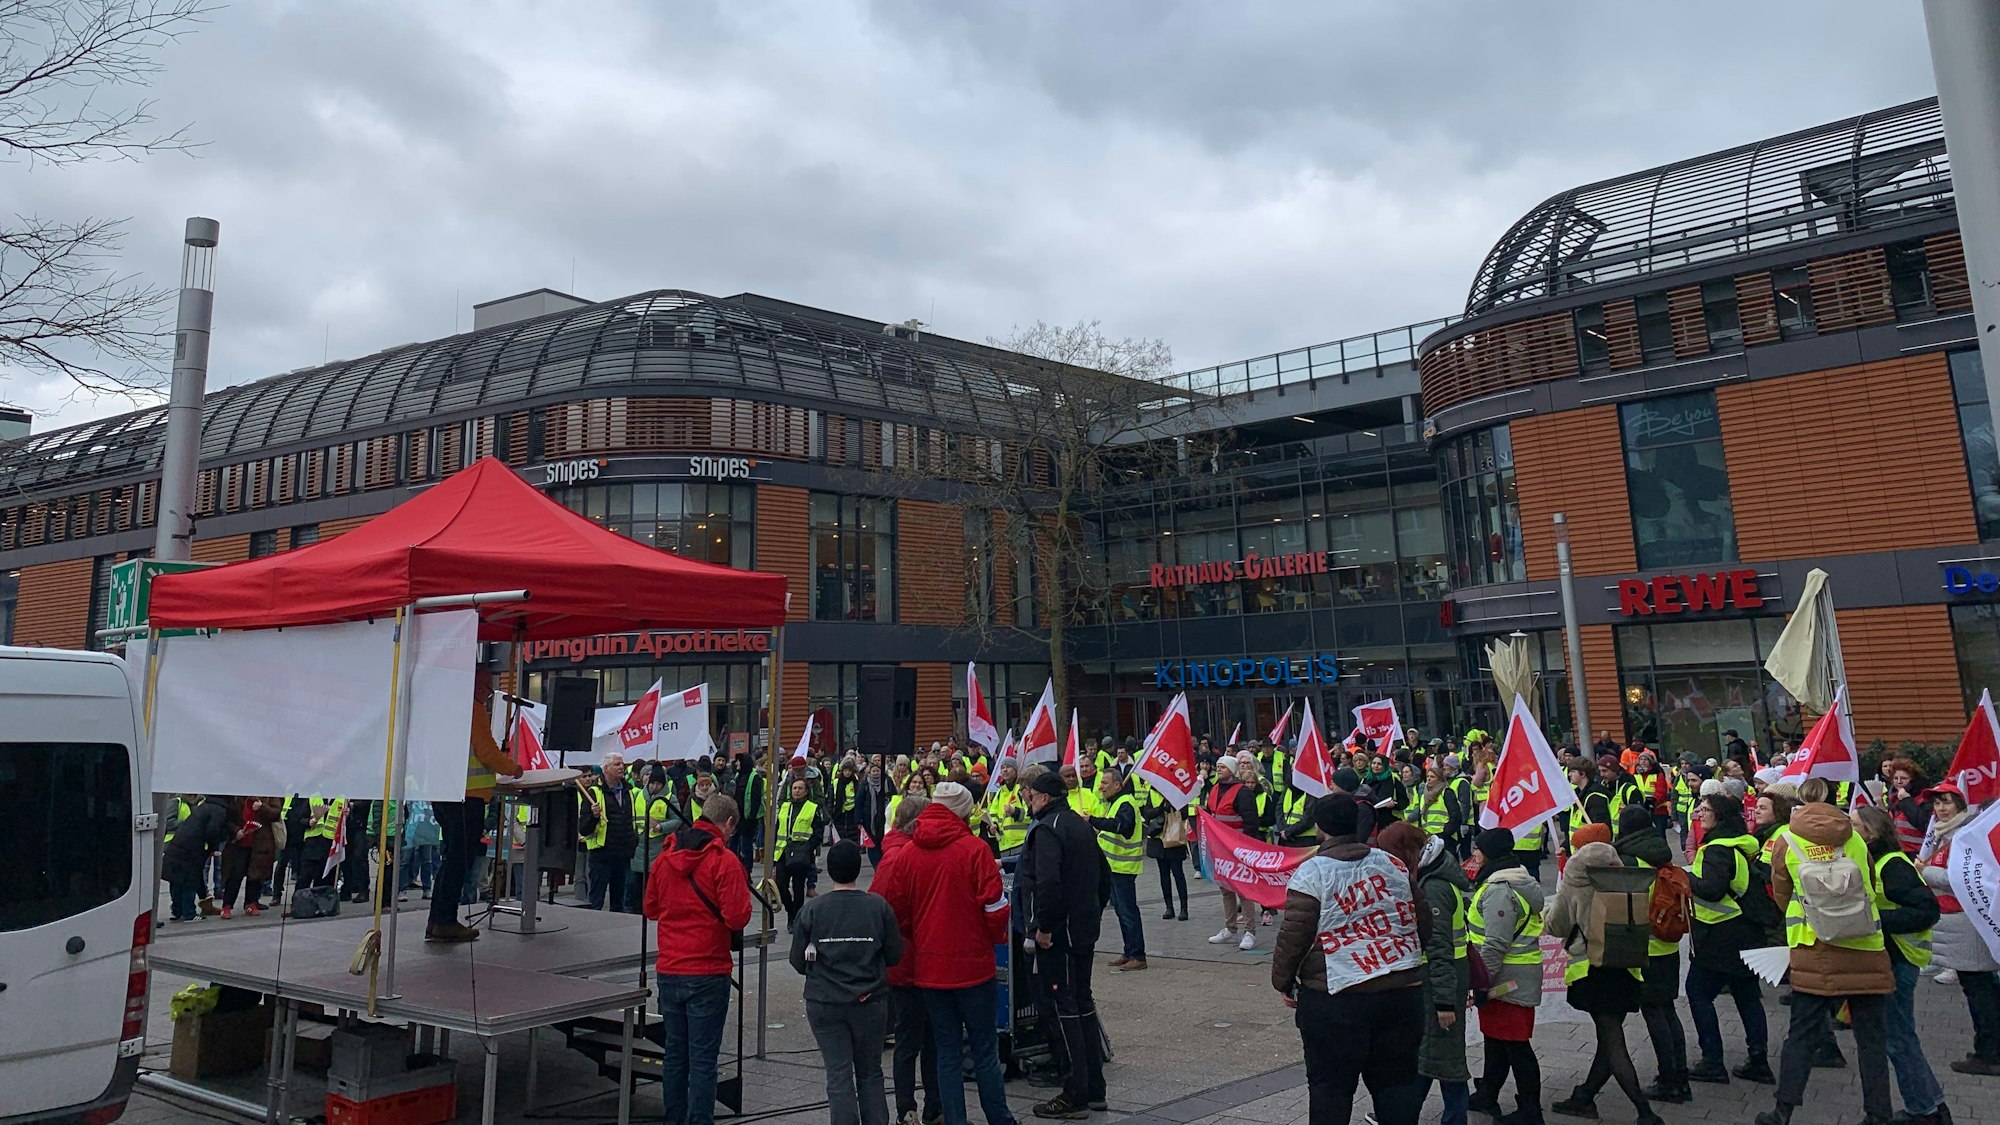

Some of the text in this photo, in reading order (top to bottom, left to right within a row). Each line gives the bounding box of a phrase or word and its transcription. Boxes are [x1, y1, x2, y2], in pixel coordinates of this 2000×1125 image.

[1618, 568, 1764, 616] REWE
[536, 627, 768, 662] Pinguin Apotheke
[1155, 654, 1340, 689] KINOPOLIS
[1333, 874, 1393, 916] WIR
[1317, 909, 1393, 955] SIND
